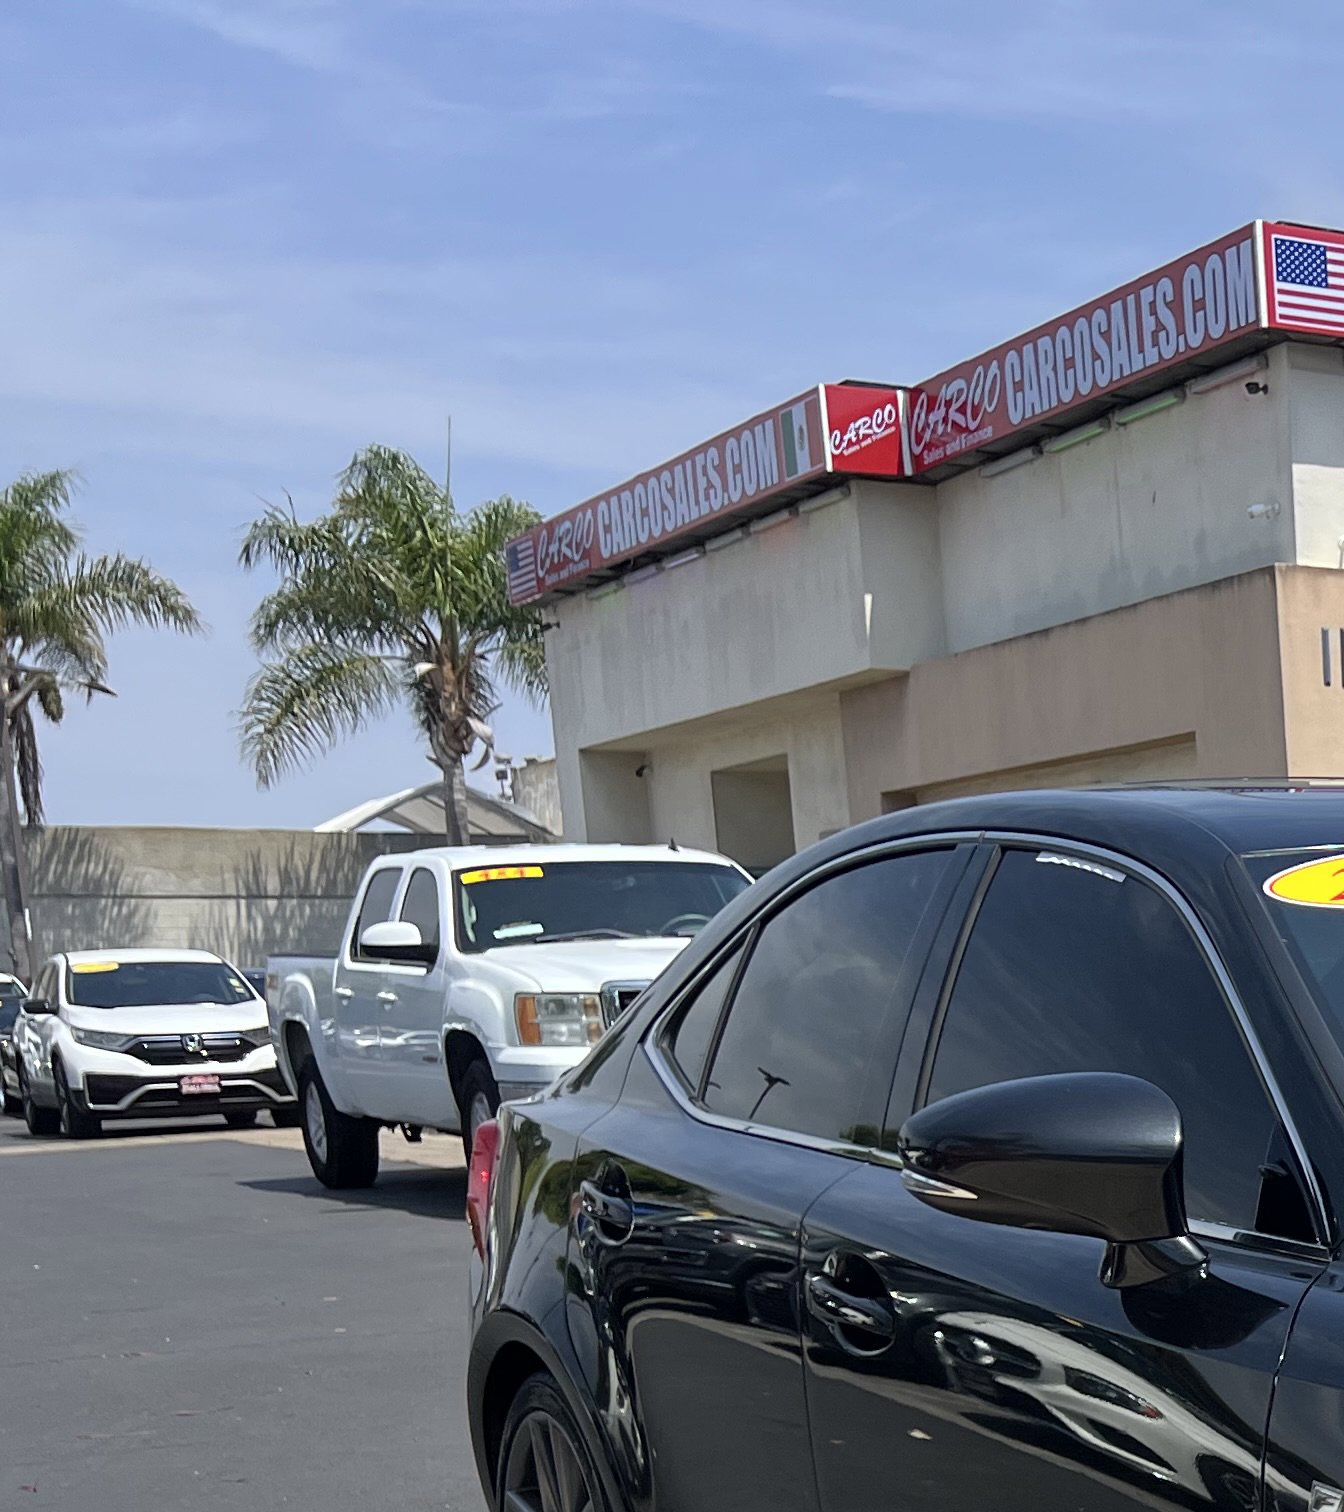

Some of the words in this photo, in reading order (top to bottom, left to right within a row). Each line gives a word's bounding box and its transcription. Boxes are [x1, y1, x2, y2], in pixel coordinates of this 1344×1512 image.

[911, 359, 1001, 456] CARCO
[1004, 238, 1257, 426] CARCOSALES.COM
[537, 508, 594, 577] CARCO
[598, 418, 779, 559] CARCOSALES.COM
[831, 403, 896, 455] CARCO
